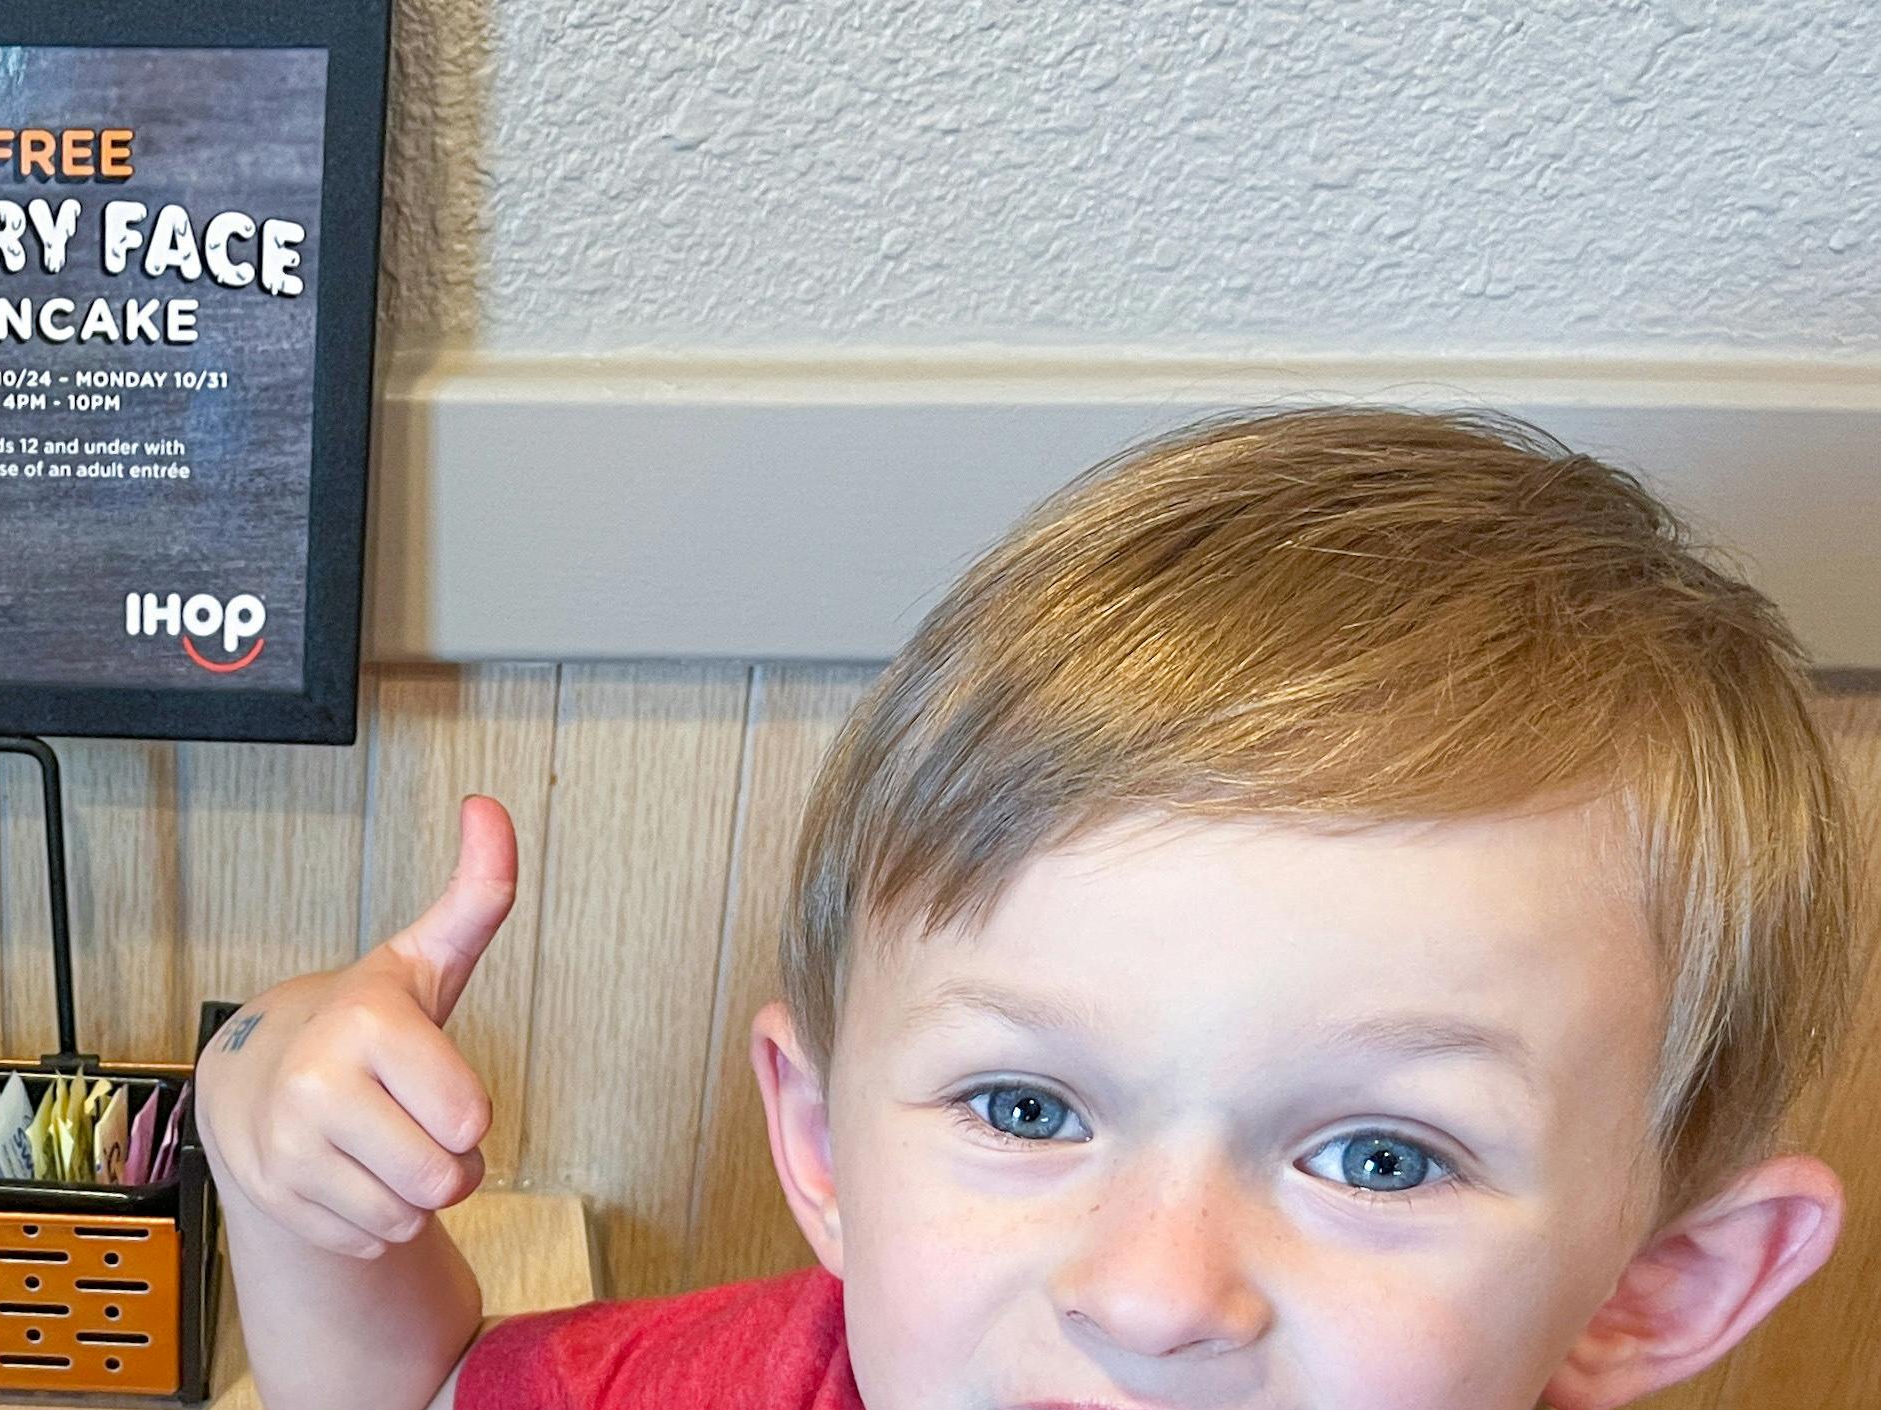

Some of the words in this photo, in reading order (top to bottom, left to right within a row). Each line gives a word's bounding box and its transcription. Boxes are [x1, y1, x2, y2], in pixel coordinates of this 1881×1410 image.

[104, 200, 306, 296] FACE
[75, 371, 167, 388] MONDAY
[174, 371, 229, 390] 10/31
[2, 394, 47, 410] 4PM
[67, 394, 120, 411] 10PM
[19, 438, 39, 455] 12
[43, 438, 79, 455] and
[84, 439, 139, 456] under
[144, 440, 185, 456] with
[23, 461, 45, 477] of
[48, 464, 72, 478] an
[76, 462, 124, 478] adult
[129, 462, 191, 480] entrée
